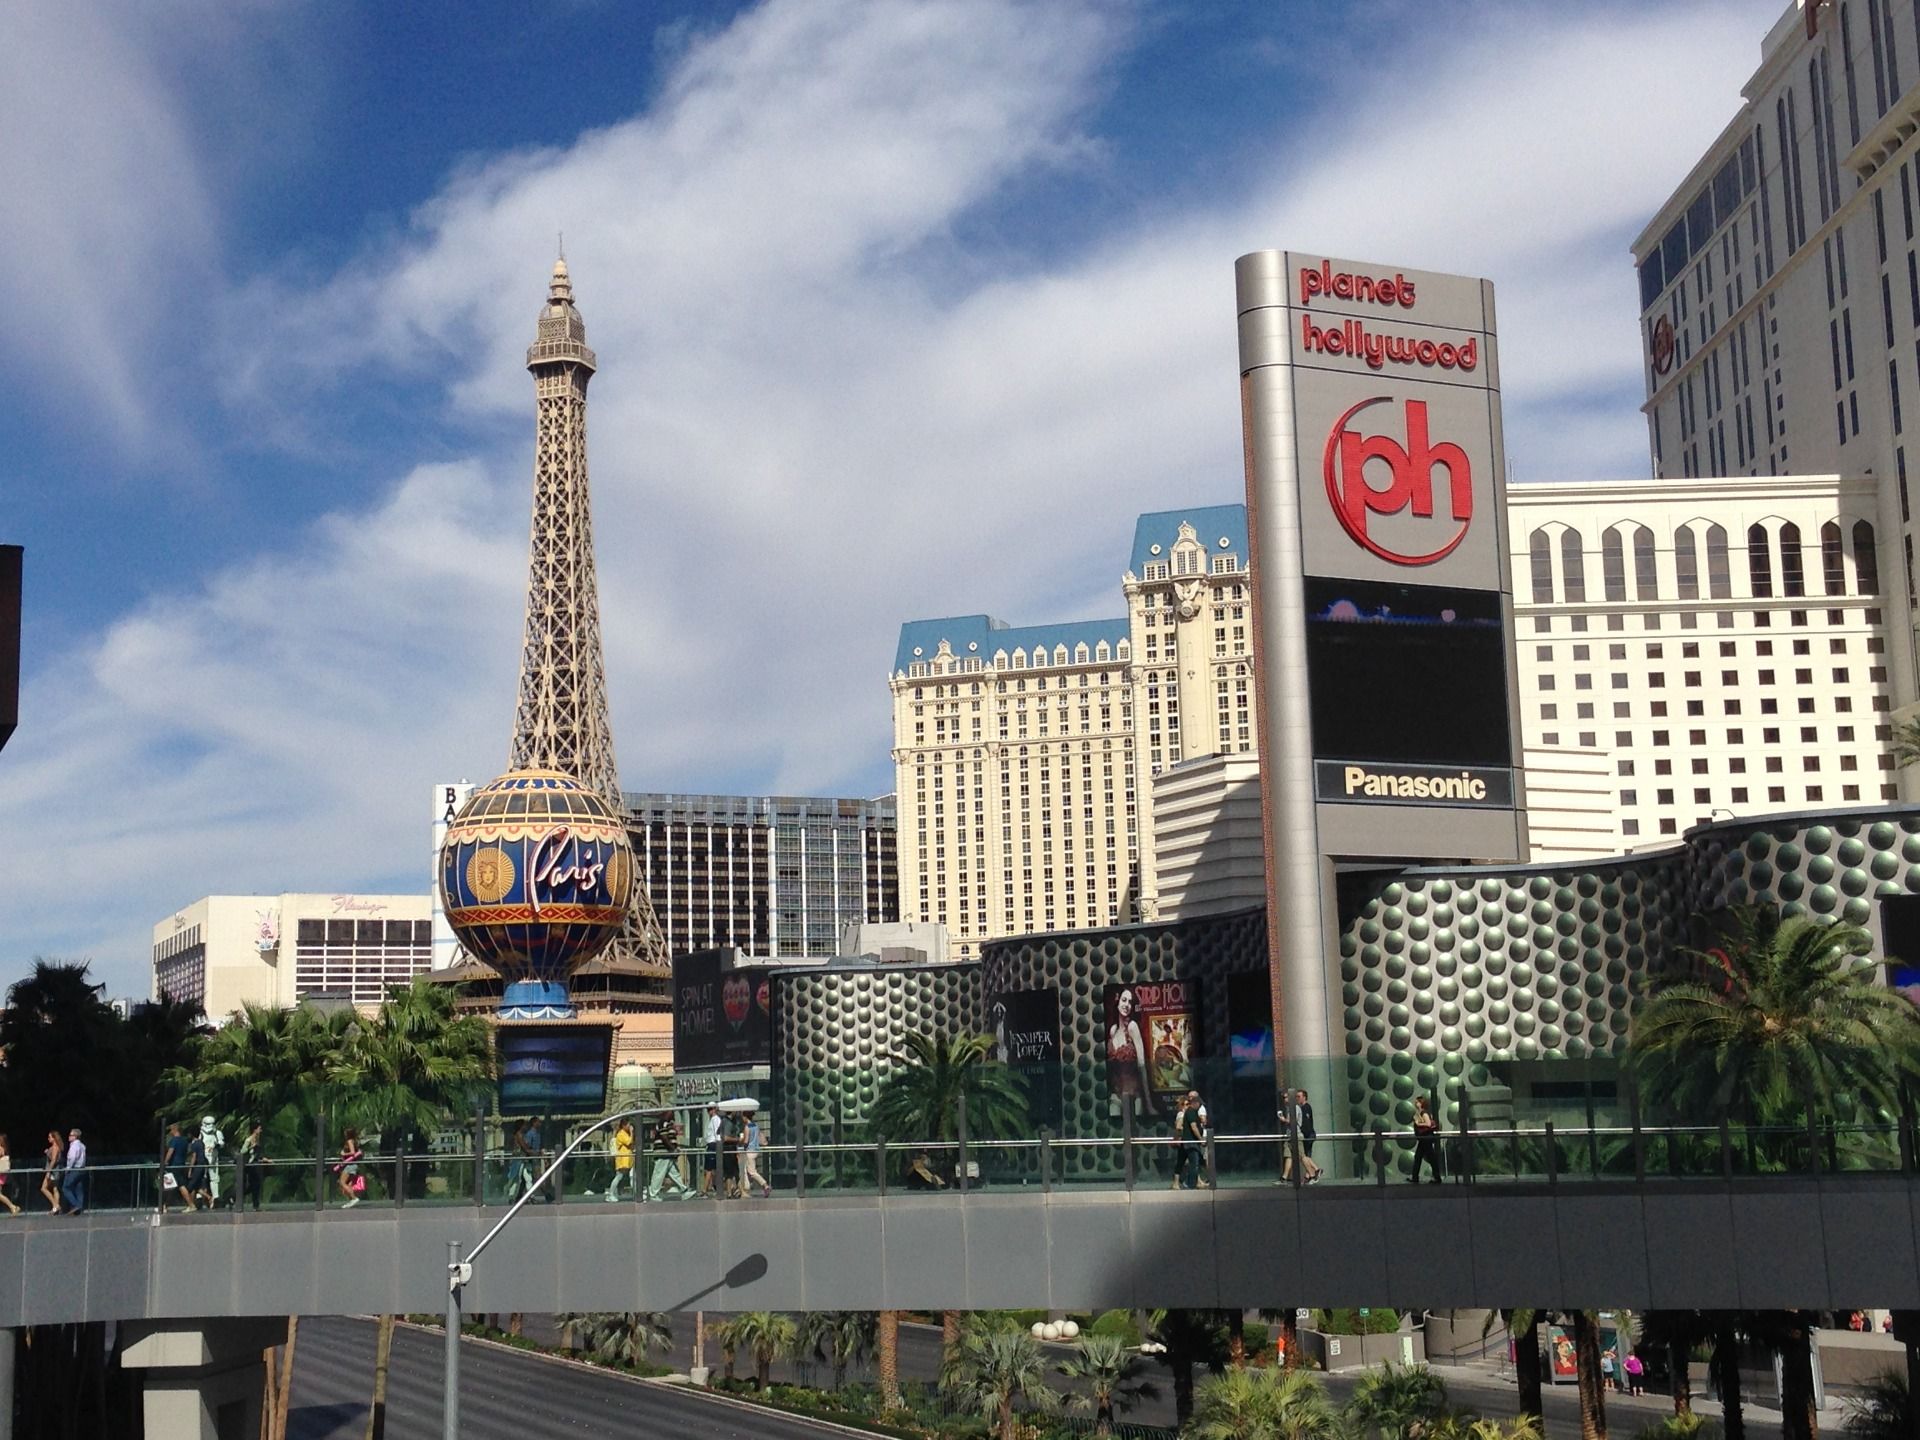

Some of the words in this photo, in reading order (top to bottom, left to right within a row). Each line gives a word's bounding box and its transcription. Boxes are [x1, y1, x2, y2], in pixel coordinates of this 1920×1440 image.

[1300, 259, 1416, 308] planet
[1302, 313, 1477, 370] hollywood
[1344, 766, 1486, 800] Panasonic
[528, 824, 604, 913] Paris
[1009, 1030, 1052, 1048] JENNIFER
